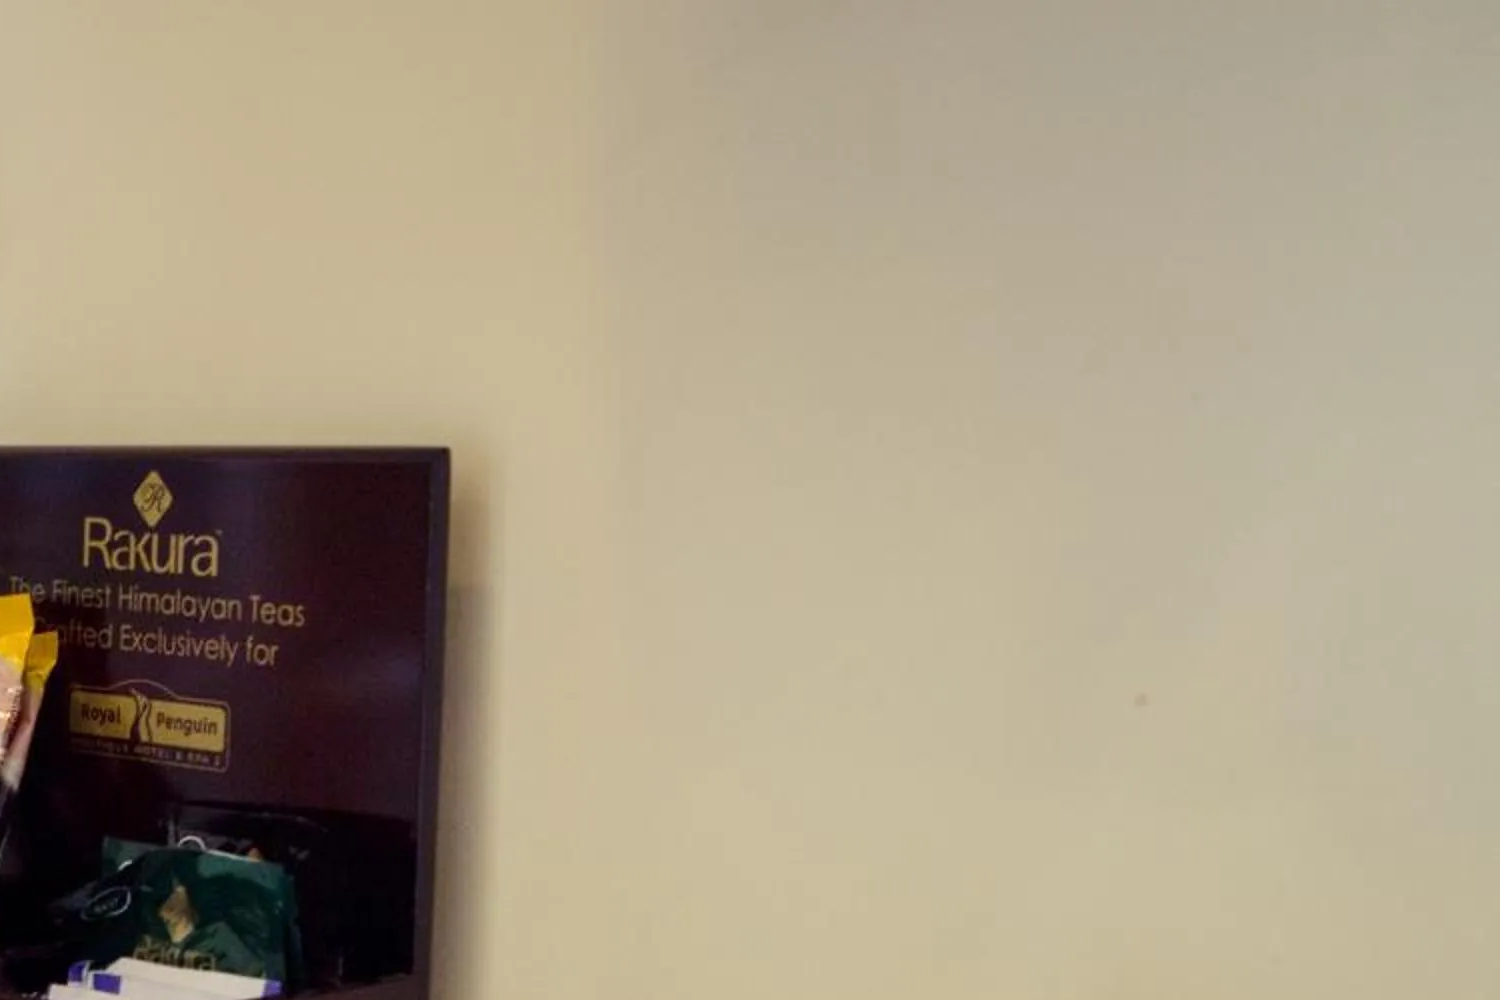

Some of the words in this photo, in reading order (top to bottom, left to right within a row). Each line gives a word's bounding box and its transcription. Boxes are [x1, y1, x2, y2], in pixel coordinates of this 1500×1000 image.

[83, 516, 219, 578] Rakura
[10, 575, 45, 603] The
[52, 578, 111, 609] Finest
[117, 583, 242, 622] Himalayan
[250, 594, 306, 628] Teas
[119, 623, 239, 668] Exclusively
[246, 634, 280, 667] for
[81, 703, 121, 725] Royal
[156, 712, 218, 737] Penguin
